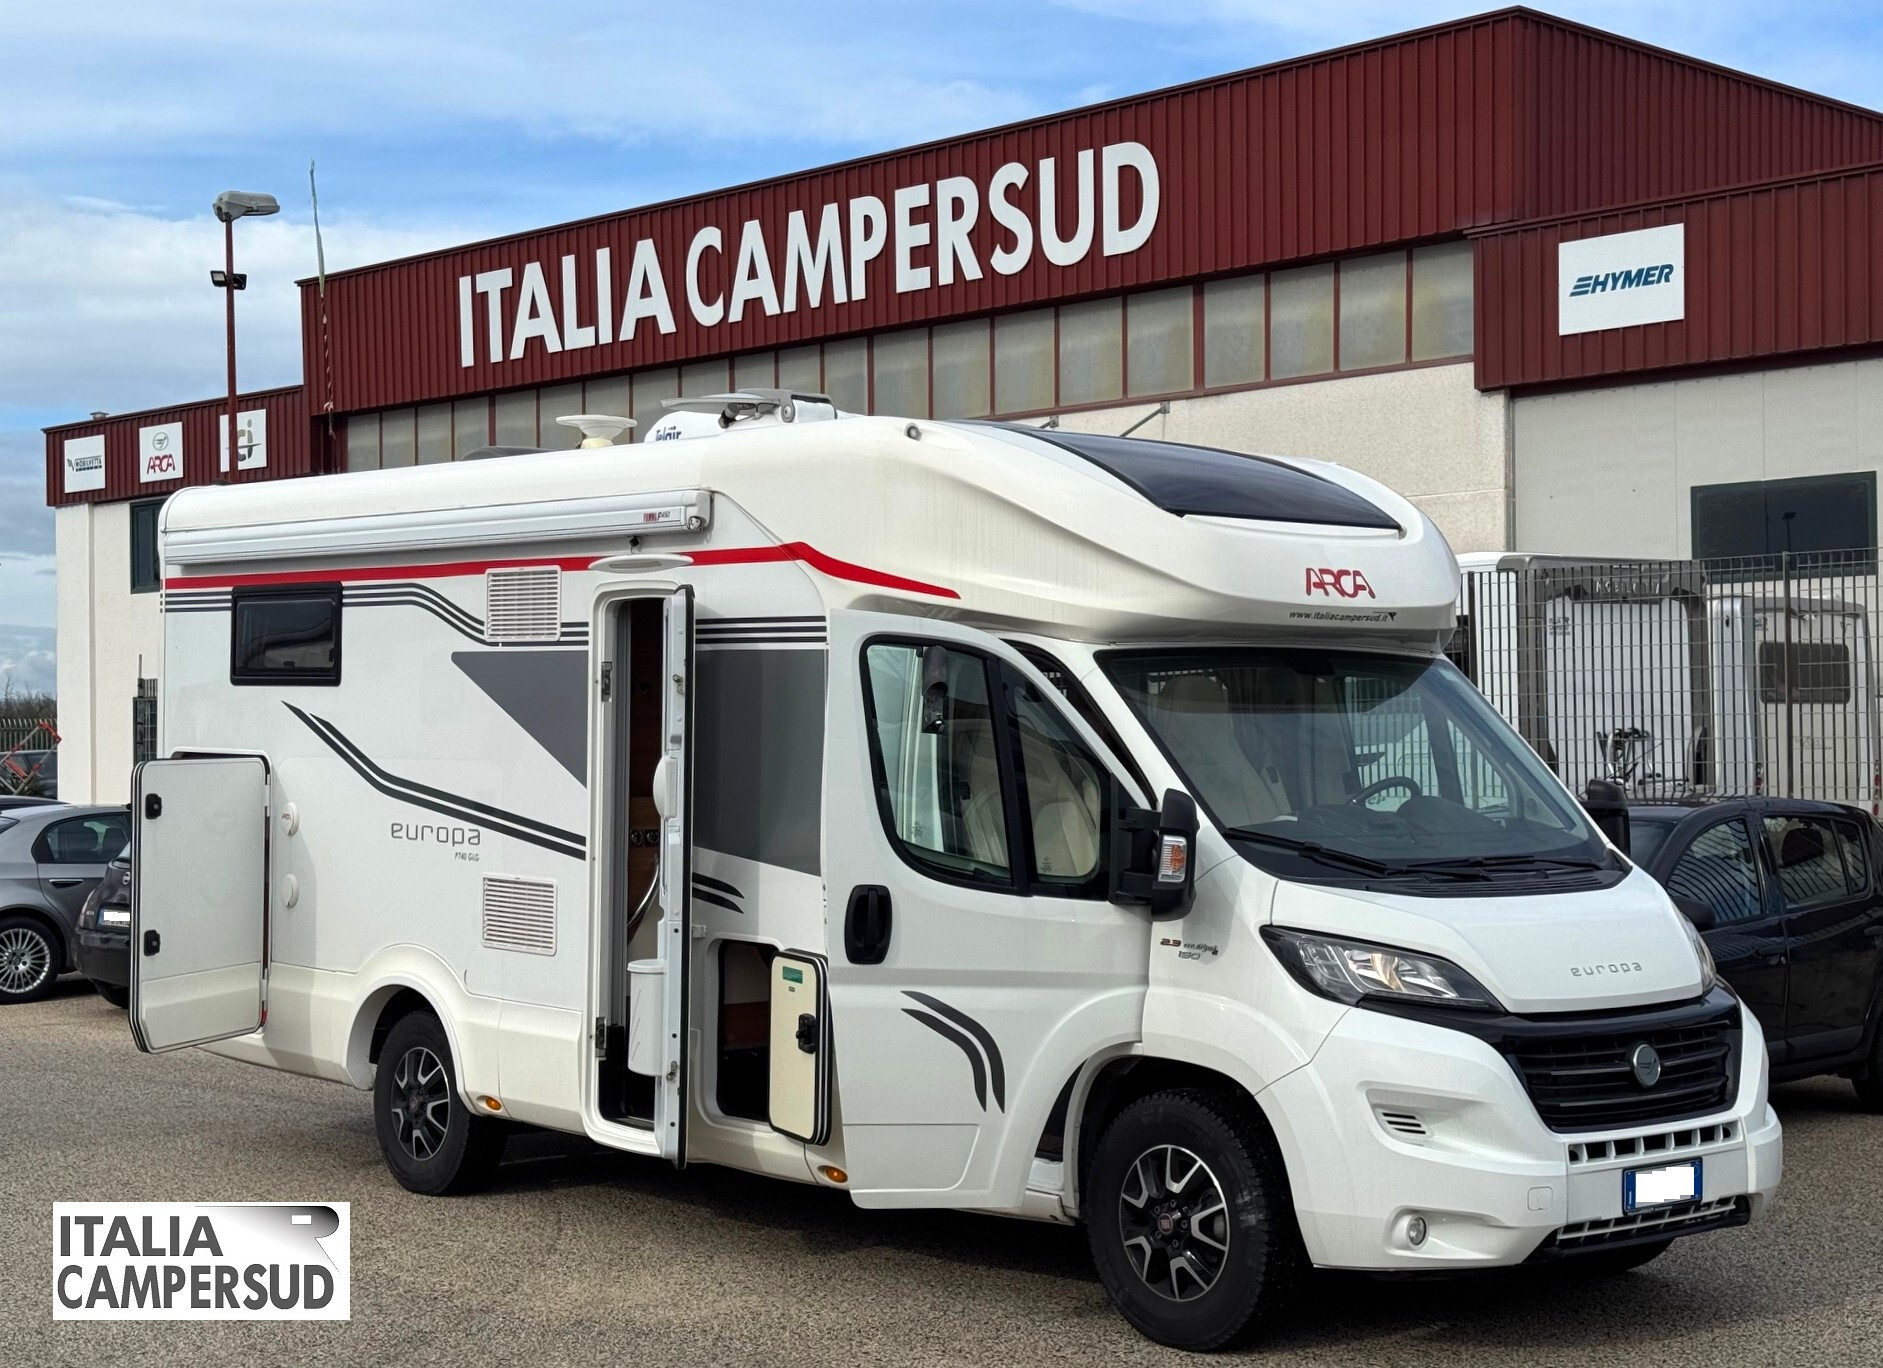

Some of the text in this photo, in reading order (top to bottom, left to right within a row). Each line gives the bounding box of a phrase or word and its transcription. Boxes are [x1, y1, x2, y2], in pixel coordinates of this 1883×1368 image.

[459, 142, 1160, 368] ITALIA CAMPERSUD
[1589, 263, 1675, 295] HYMER
[146, 453, 176, 475] ARCA
[1305, 567, 1376, 600] ARCA
[1288, 611, 1389, 624] www.italiacampersud.it
[390, 823, 481, 847] europa
[1570, 961, 1643, 978] europa
